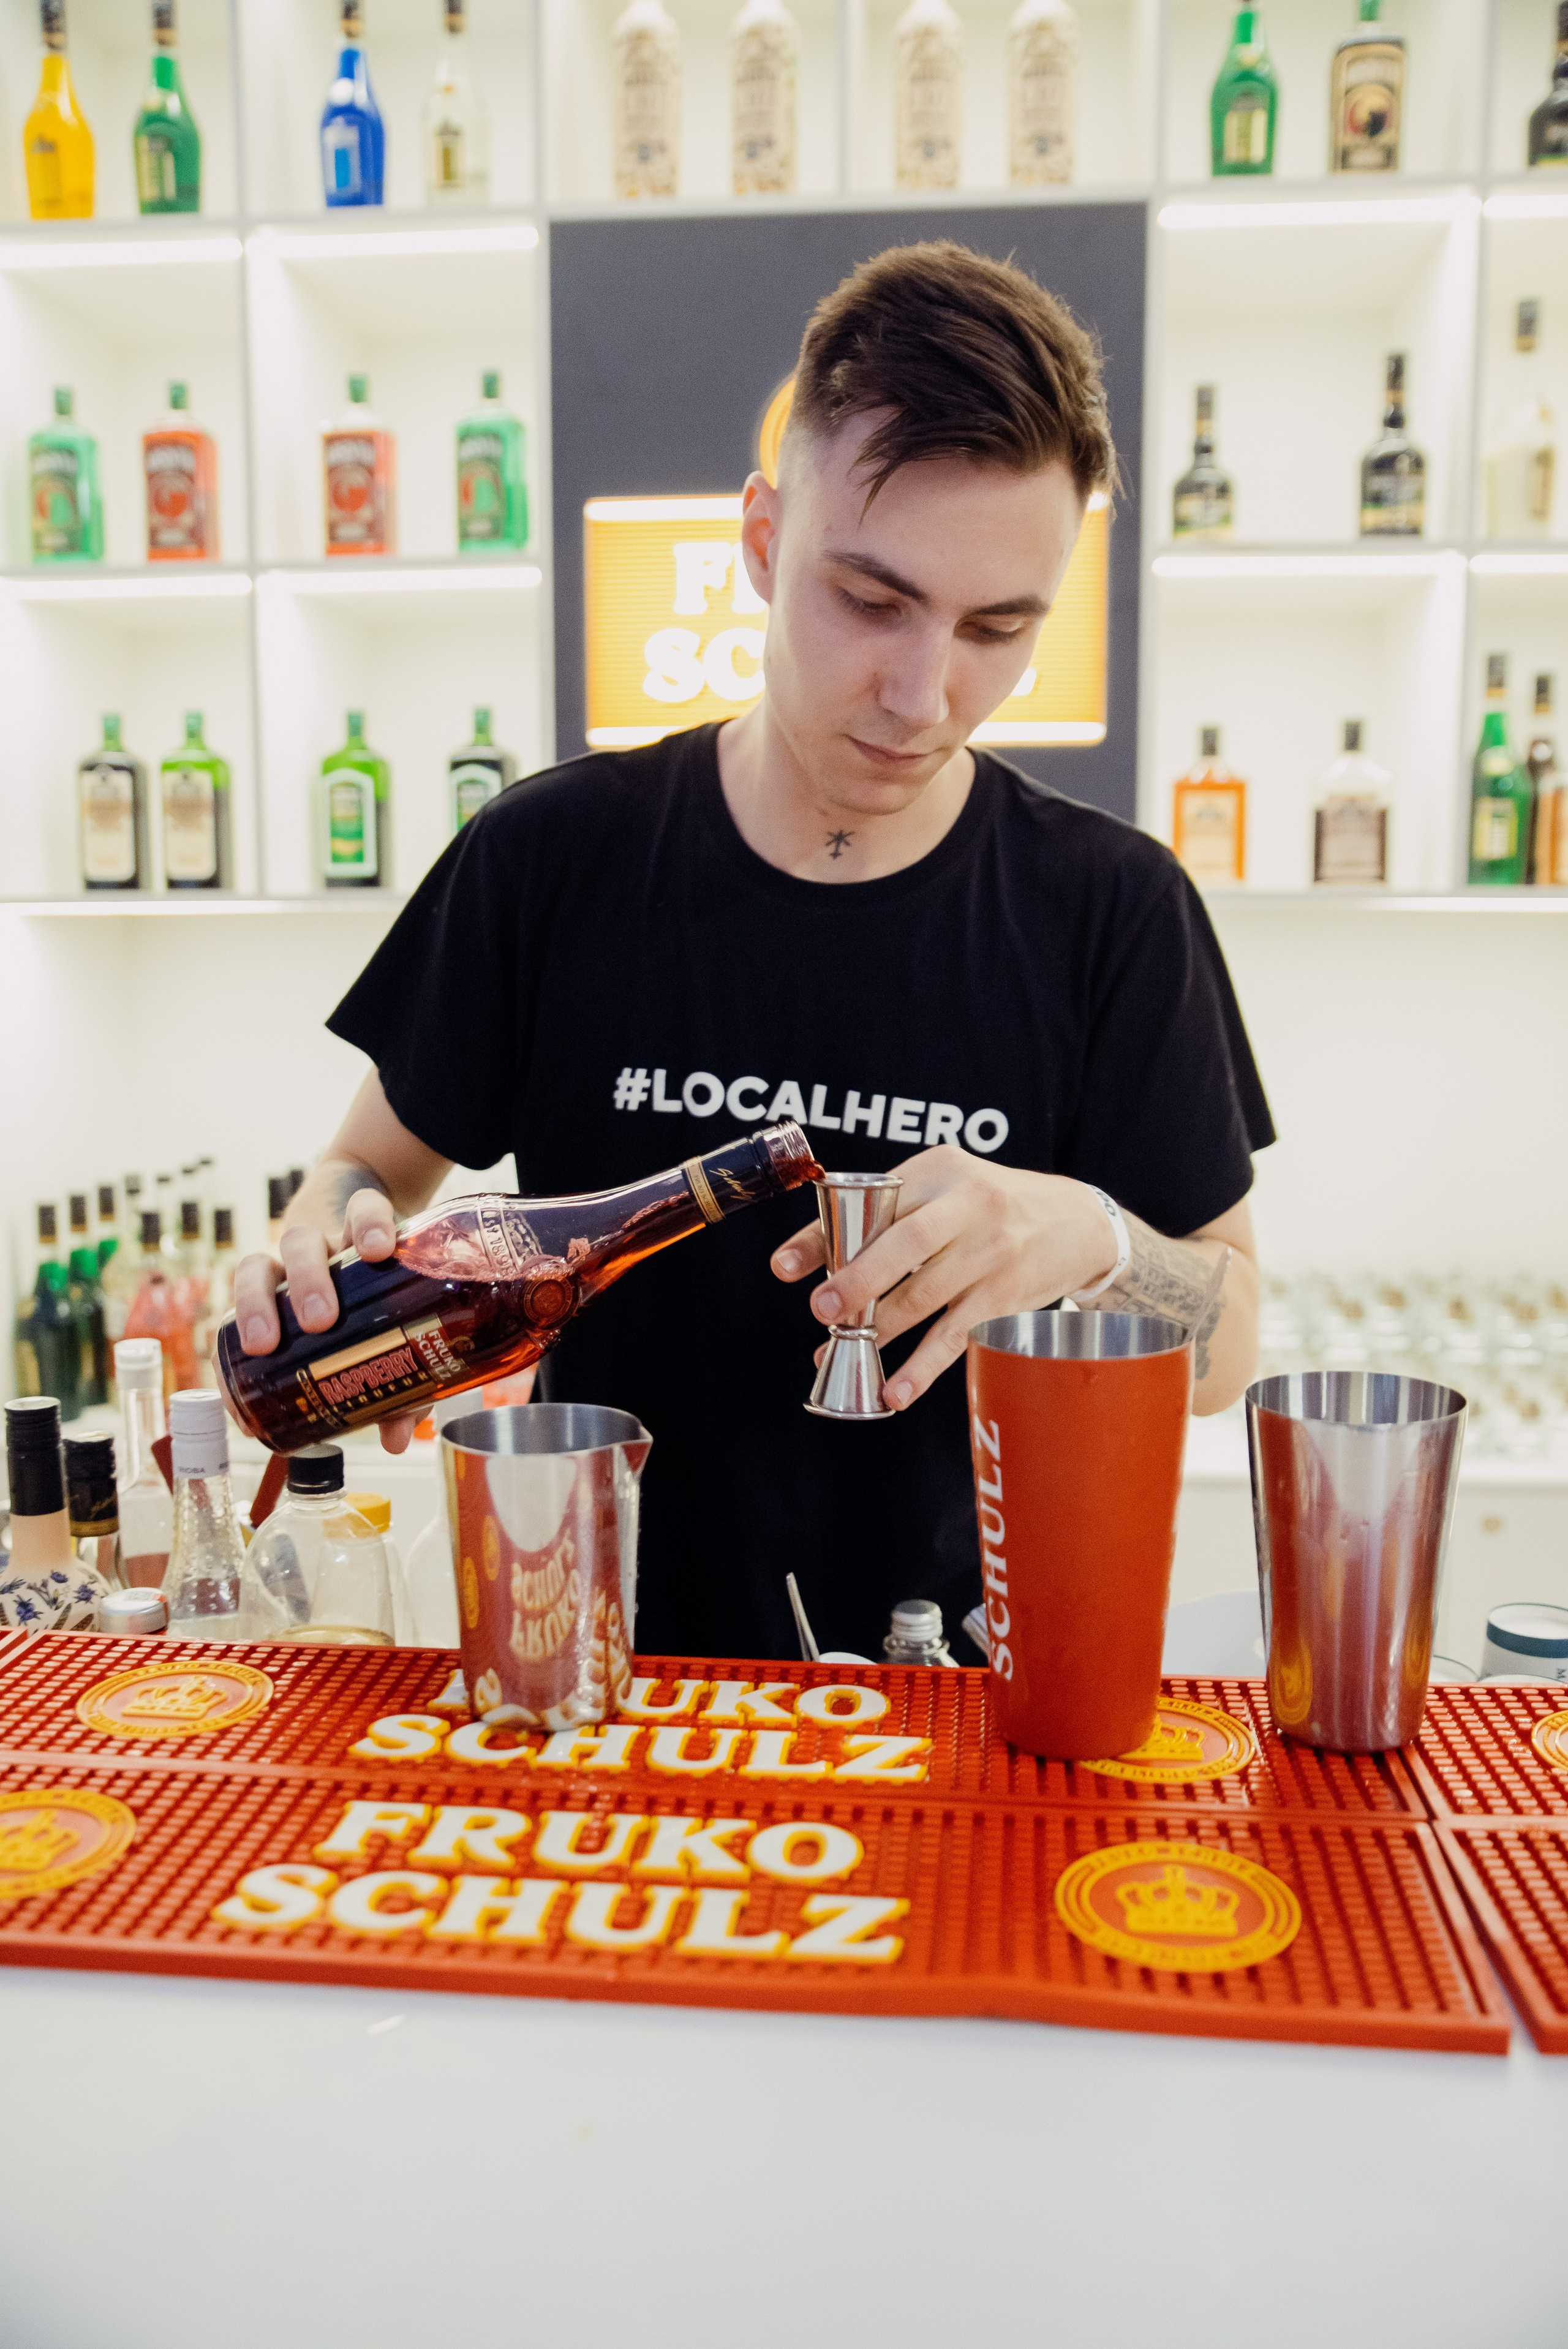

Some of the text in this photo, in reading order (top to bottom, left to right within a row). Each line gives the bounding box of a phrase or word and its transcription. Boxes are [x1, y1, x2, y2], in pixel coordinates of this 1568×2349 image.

[614, 1068, 1009, 1153] #LOCALHERO
[318, 1347, 418, 1404] RASPBERRY
[415, 1329, 461, 1379] FRUKO SCHULZ
[974, 1414, 1014, 1681] SCHULZ
[349, 1714, 932, 1783] SCHULZ
[314, 1800, 864, 1885] FRUKO
[212, 1863, 910, 1963] SCHULZ
